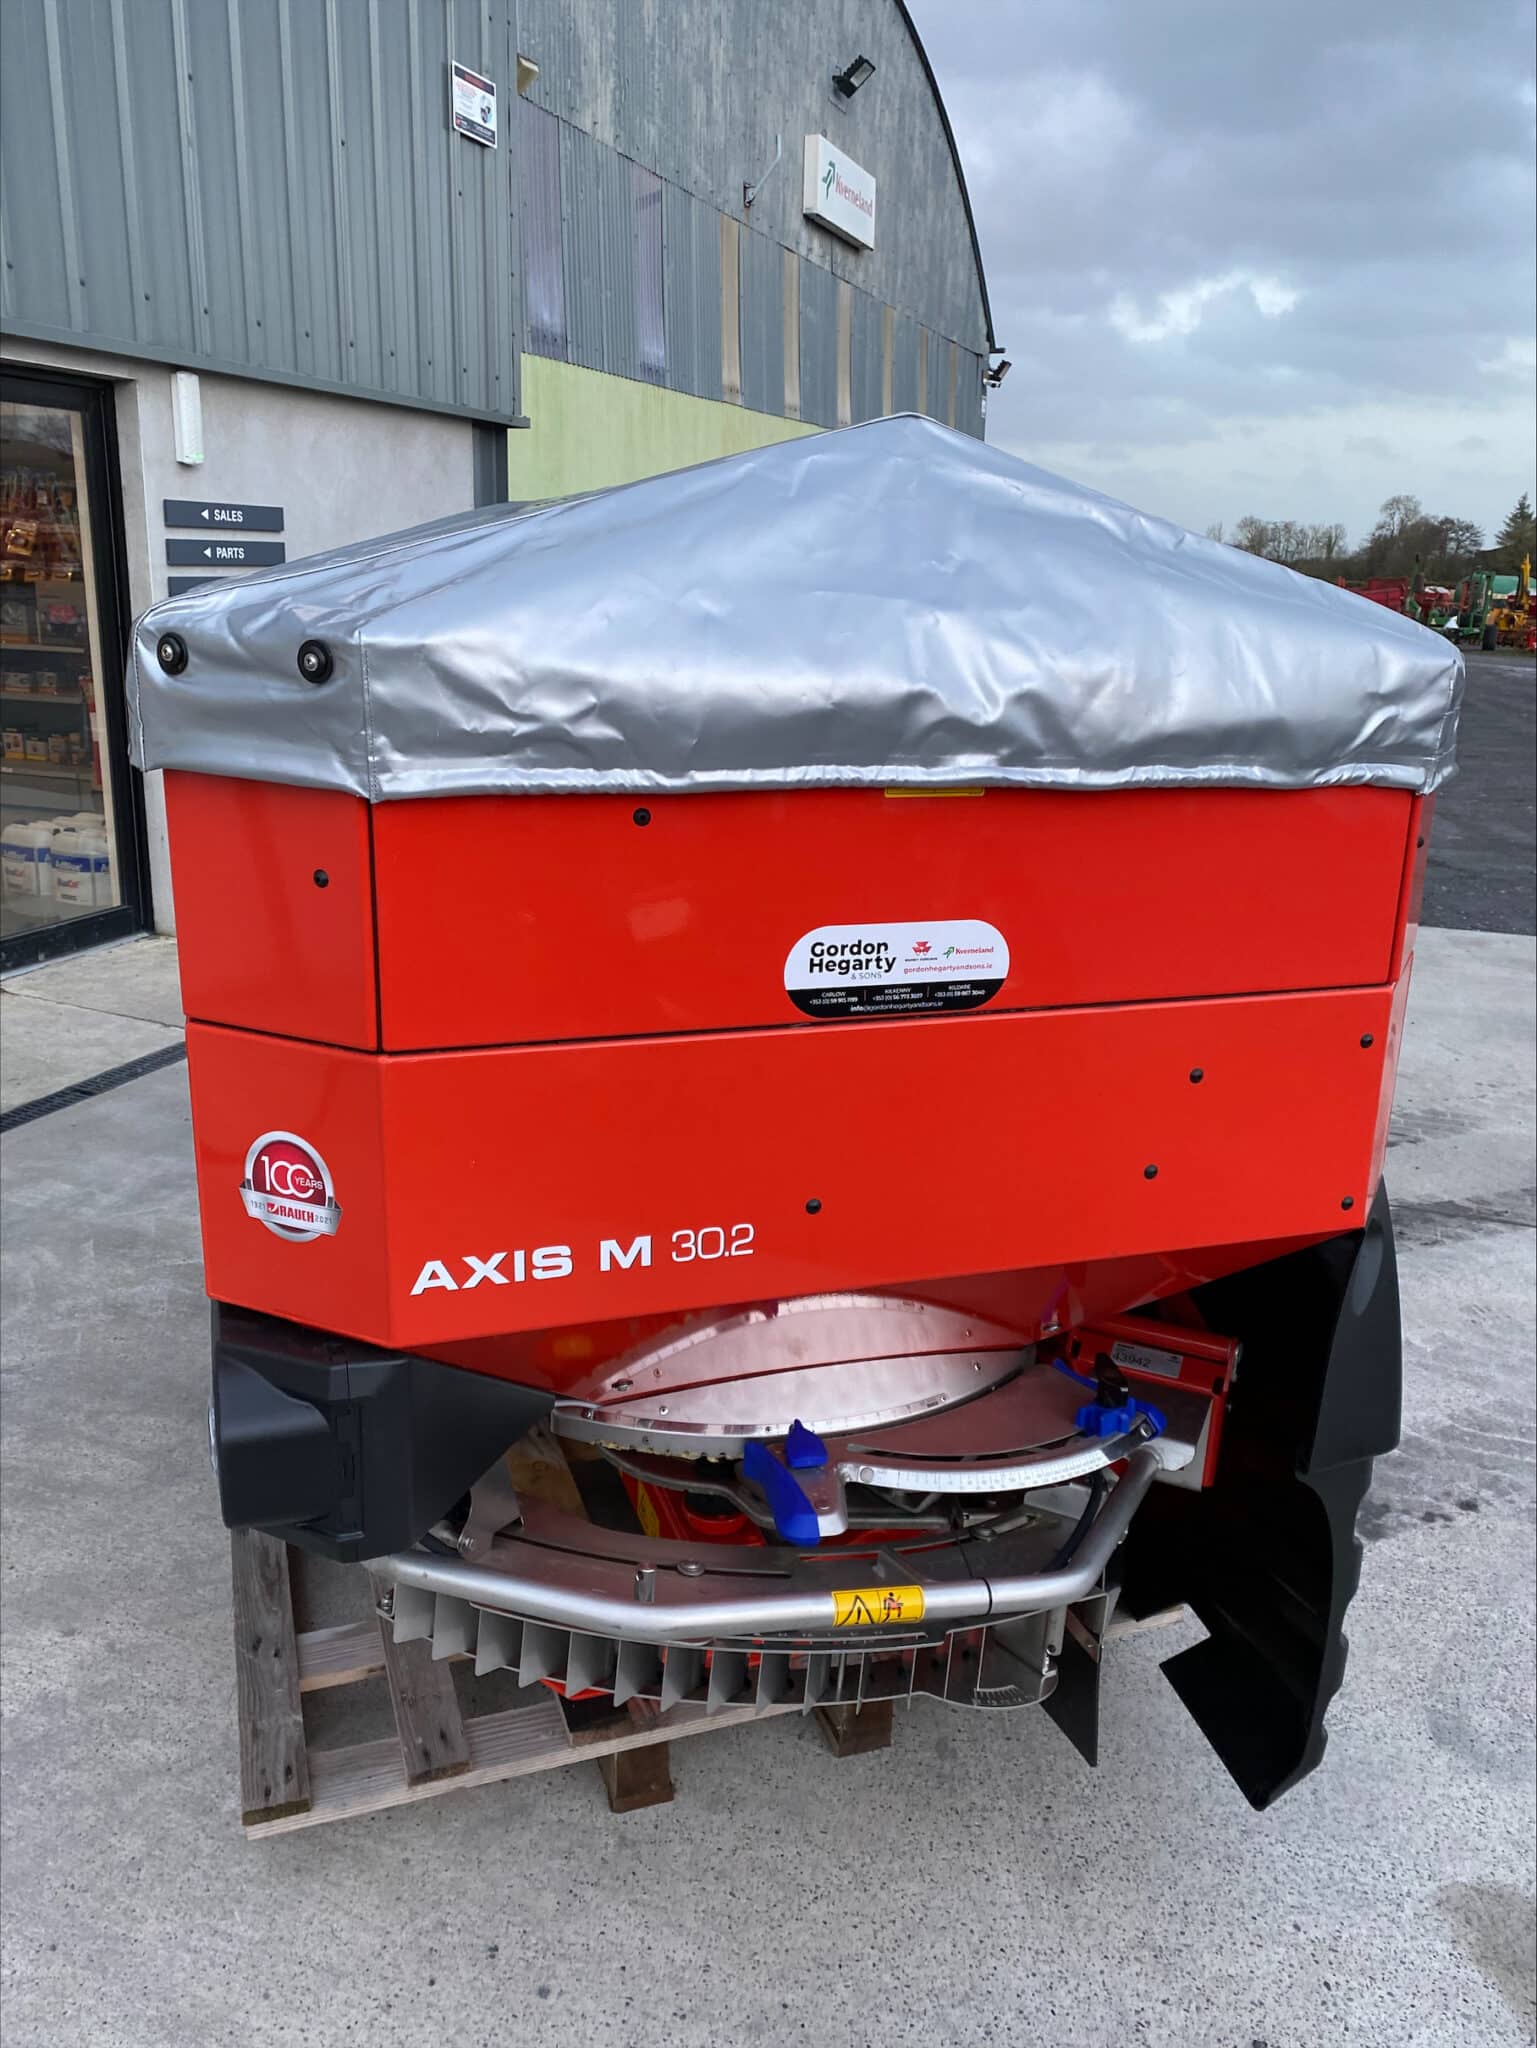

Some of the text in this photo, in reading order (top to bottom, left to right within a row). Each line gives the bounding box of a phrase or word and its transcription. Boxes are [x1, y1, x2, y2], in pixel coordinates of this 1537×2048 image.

[835, 172, 873, 218] Kverneland
[214, 509, 243, 522] SALES
[215, 547, 245, 559] PARTS
[810, 939, 889, 957] Gordon
[809, 956, 897, 976] Hegarty
[903, 963, 993, 975] gordonhegartyandsons.ie
[859, 972, 882, 980] SONS
[261, 1155, 315, 1199] 100
[294, 1176, 324, 1190] YEARS
[280, 1205, 314, 1223] RAUCH
[409, 1223, 755, 1296] AXIS M 30.2
